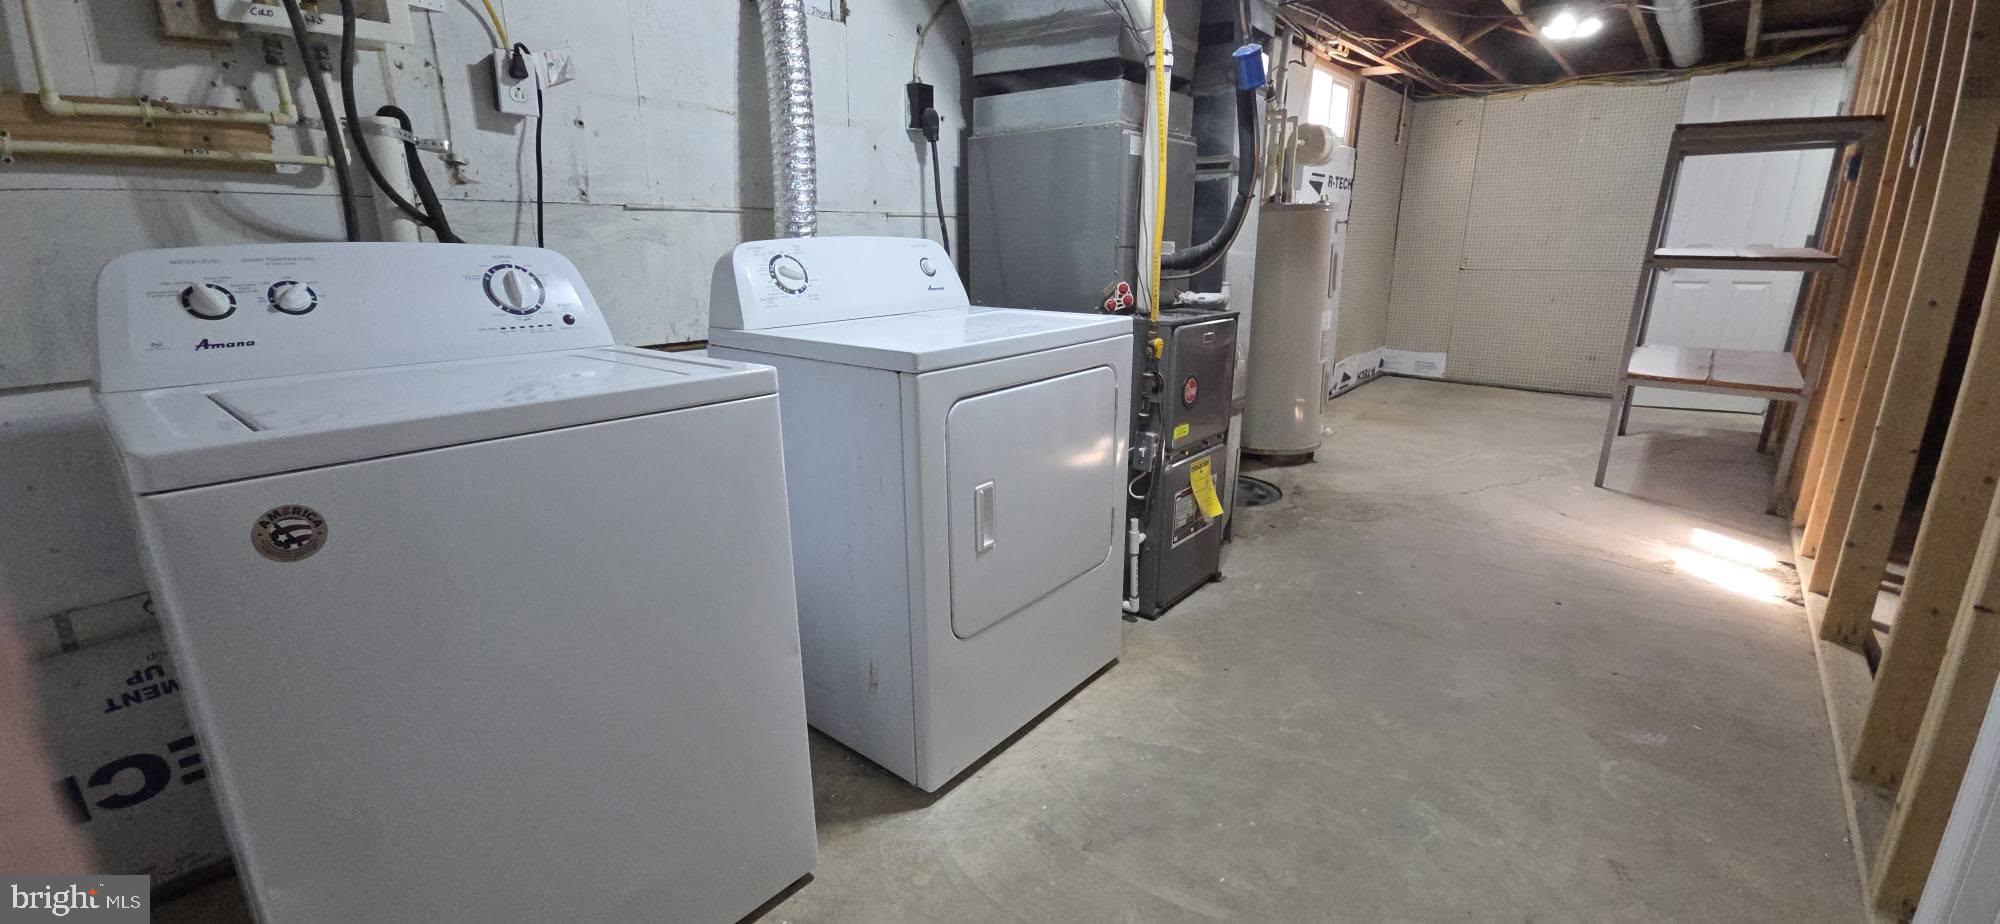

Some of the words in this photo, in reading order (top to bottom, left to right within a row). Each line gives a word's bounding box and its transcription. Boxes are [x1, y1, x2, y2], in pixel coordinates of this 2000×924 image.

[1328, 175, 1352, 191] R-TECH
[195, 338, 256, 352] Amana
[259, 506, 322, 529] AMERICA
[126, 665, 166, 687] UP
